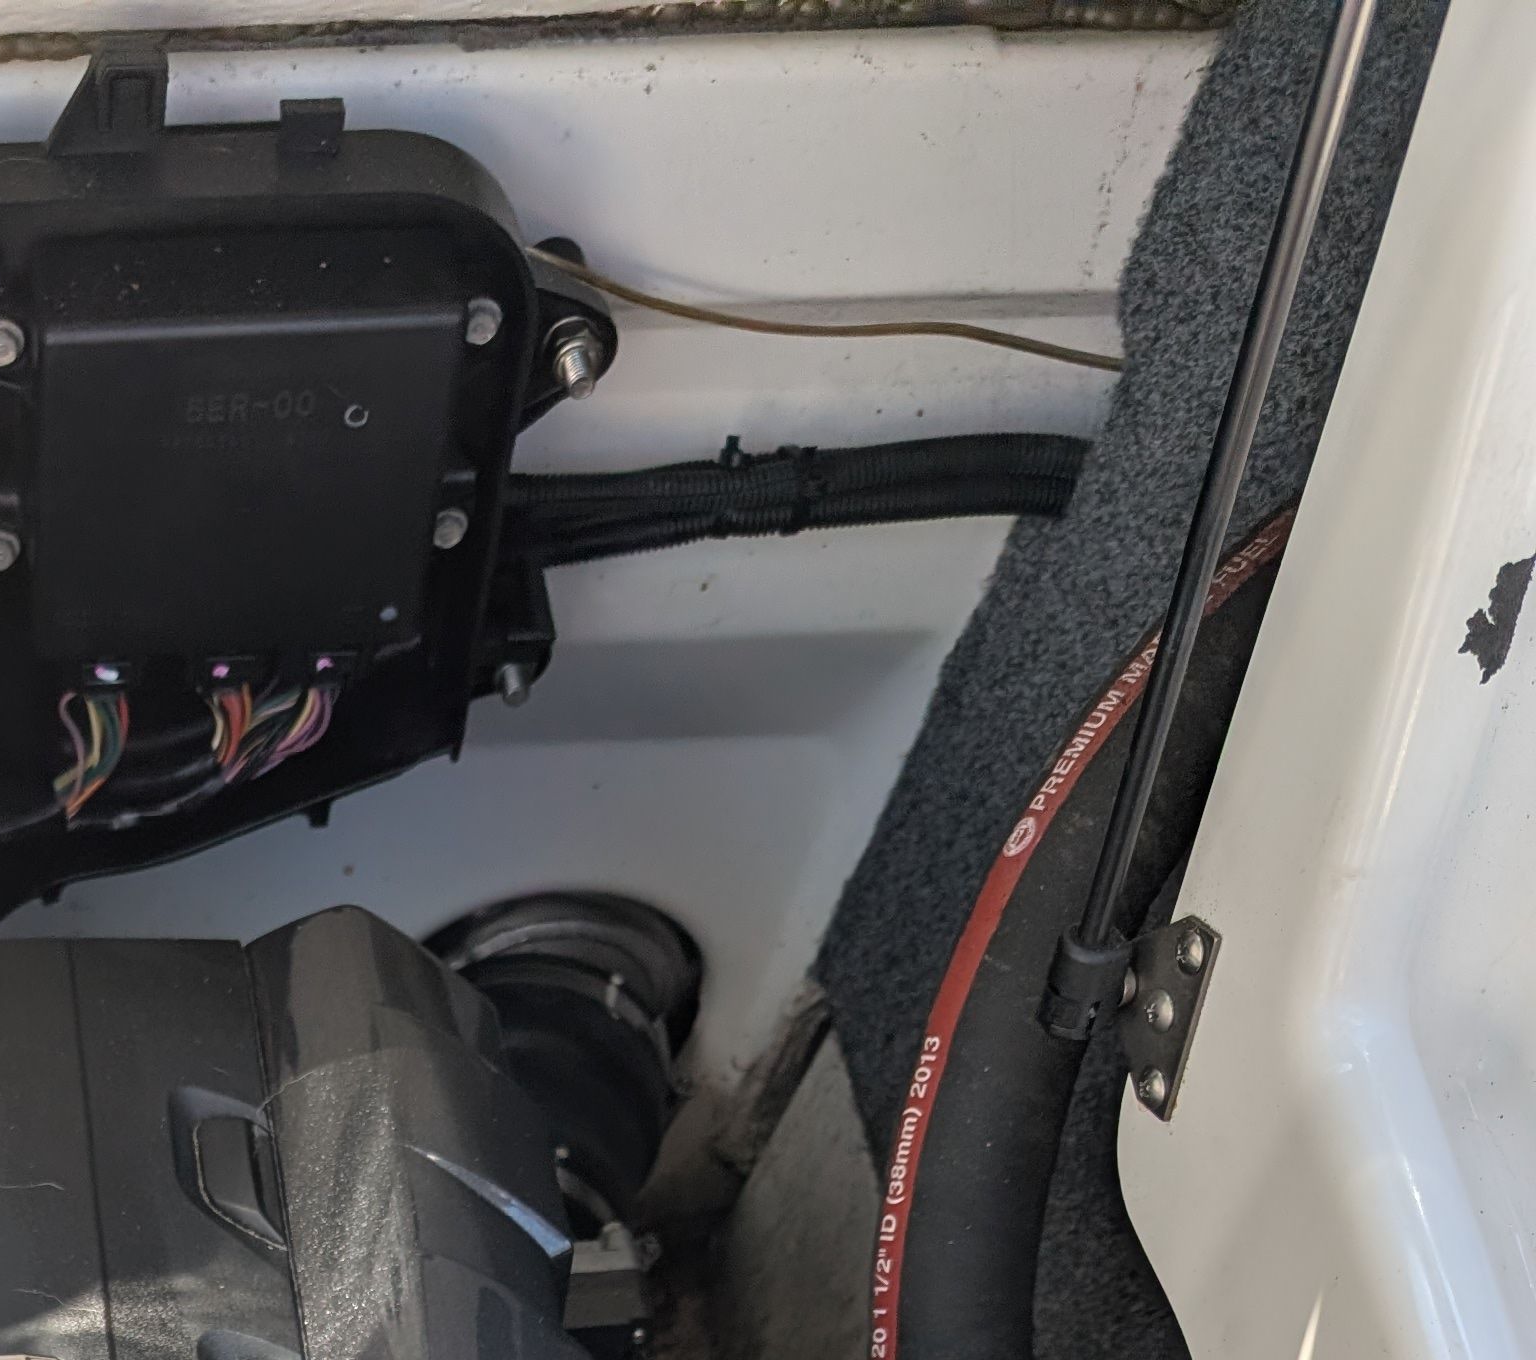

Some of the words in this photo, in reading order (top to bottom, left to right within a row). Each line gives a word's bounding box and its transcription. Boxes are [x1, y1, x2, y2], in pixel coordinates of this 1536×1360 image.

[1028, 690, 1126, 813] PREMIUM
[910, 1035, 941, 1099] 2013
[885, 1107, 923, 1204] (38mm)
[879, 1213, 897, 1242] ID
[873, 1247, 892, 1296] 1/2"
